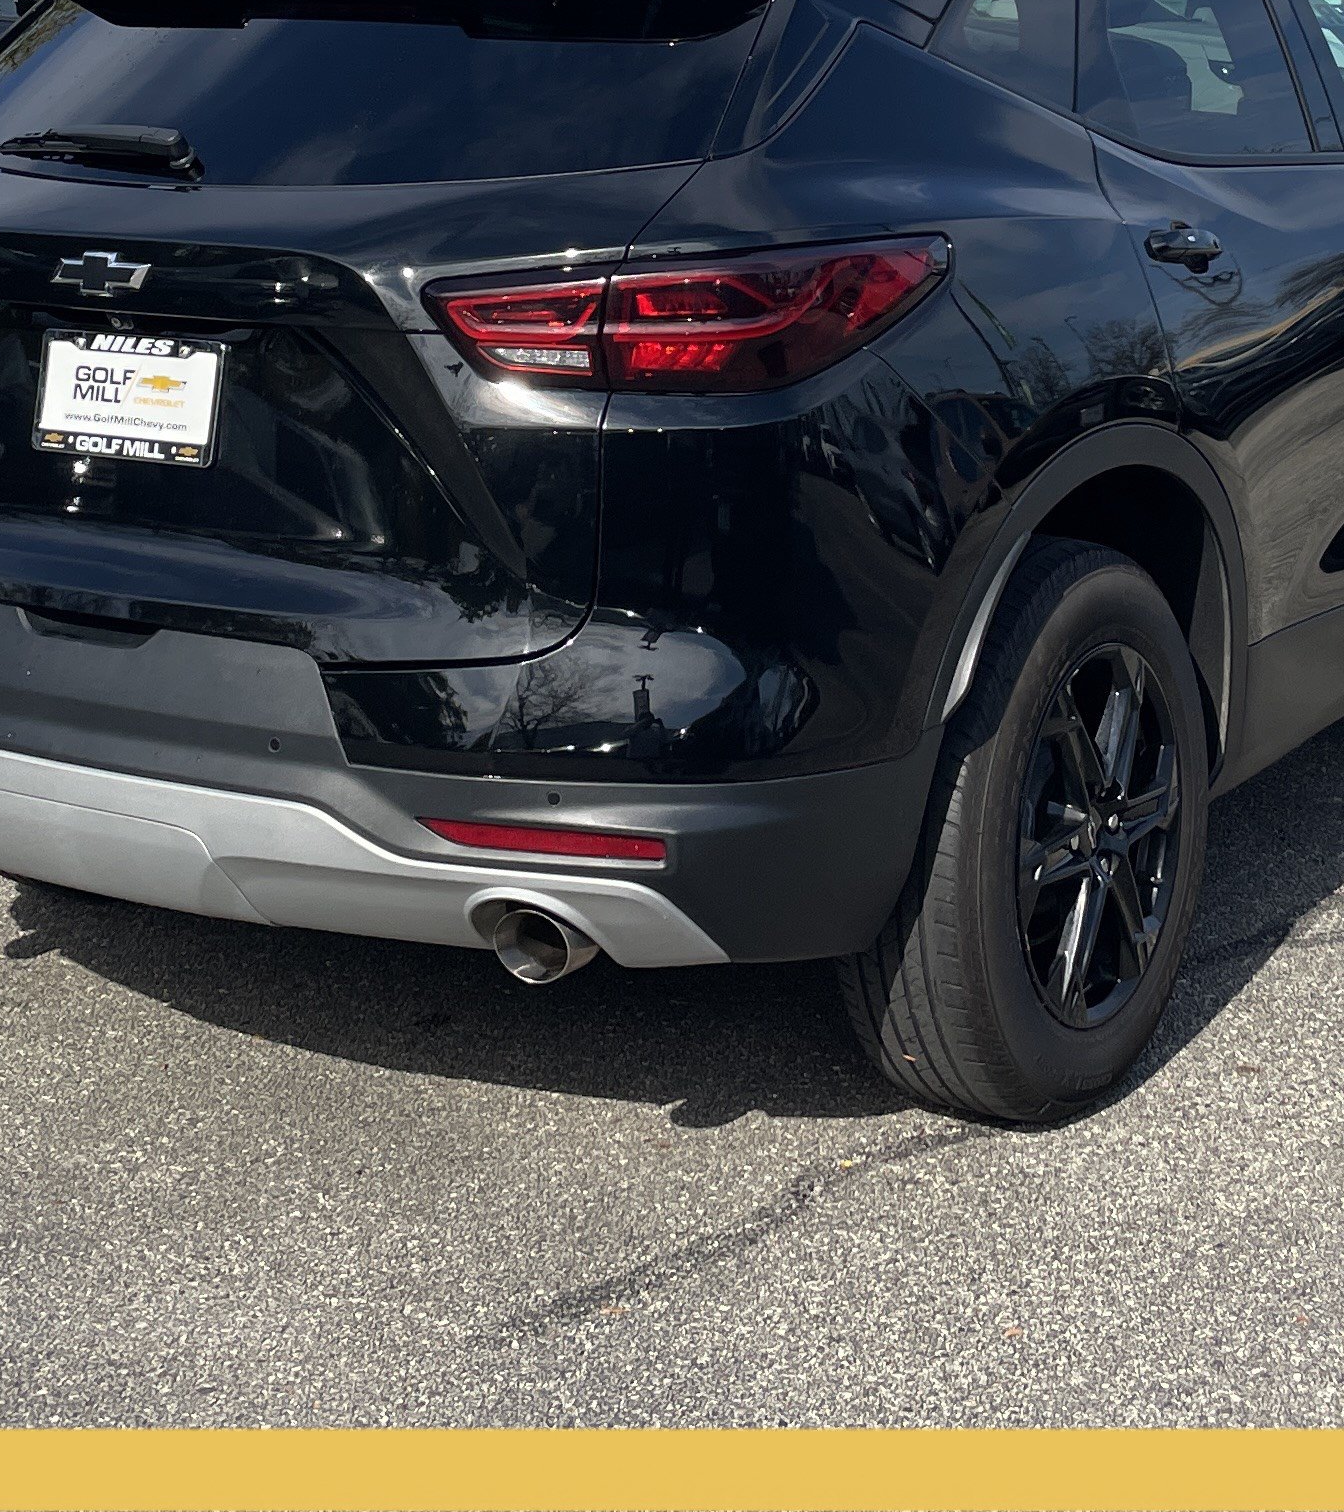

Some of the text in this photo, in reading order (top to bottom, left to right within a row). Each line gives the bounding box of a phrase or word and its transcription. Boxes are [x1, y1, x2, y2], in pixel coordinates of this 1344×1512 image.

[90, 334, 175, 356] NILES
[74, 365, 136, 386] GOLF
[72, 384, 121, 404] MILL
[64, 411, 188, 431] www.GolfMillChevy.com
